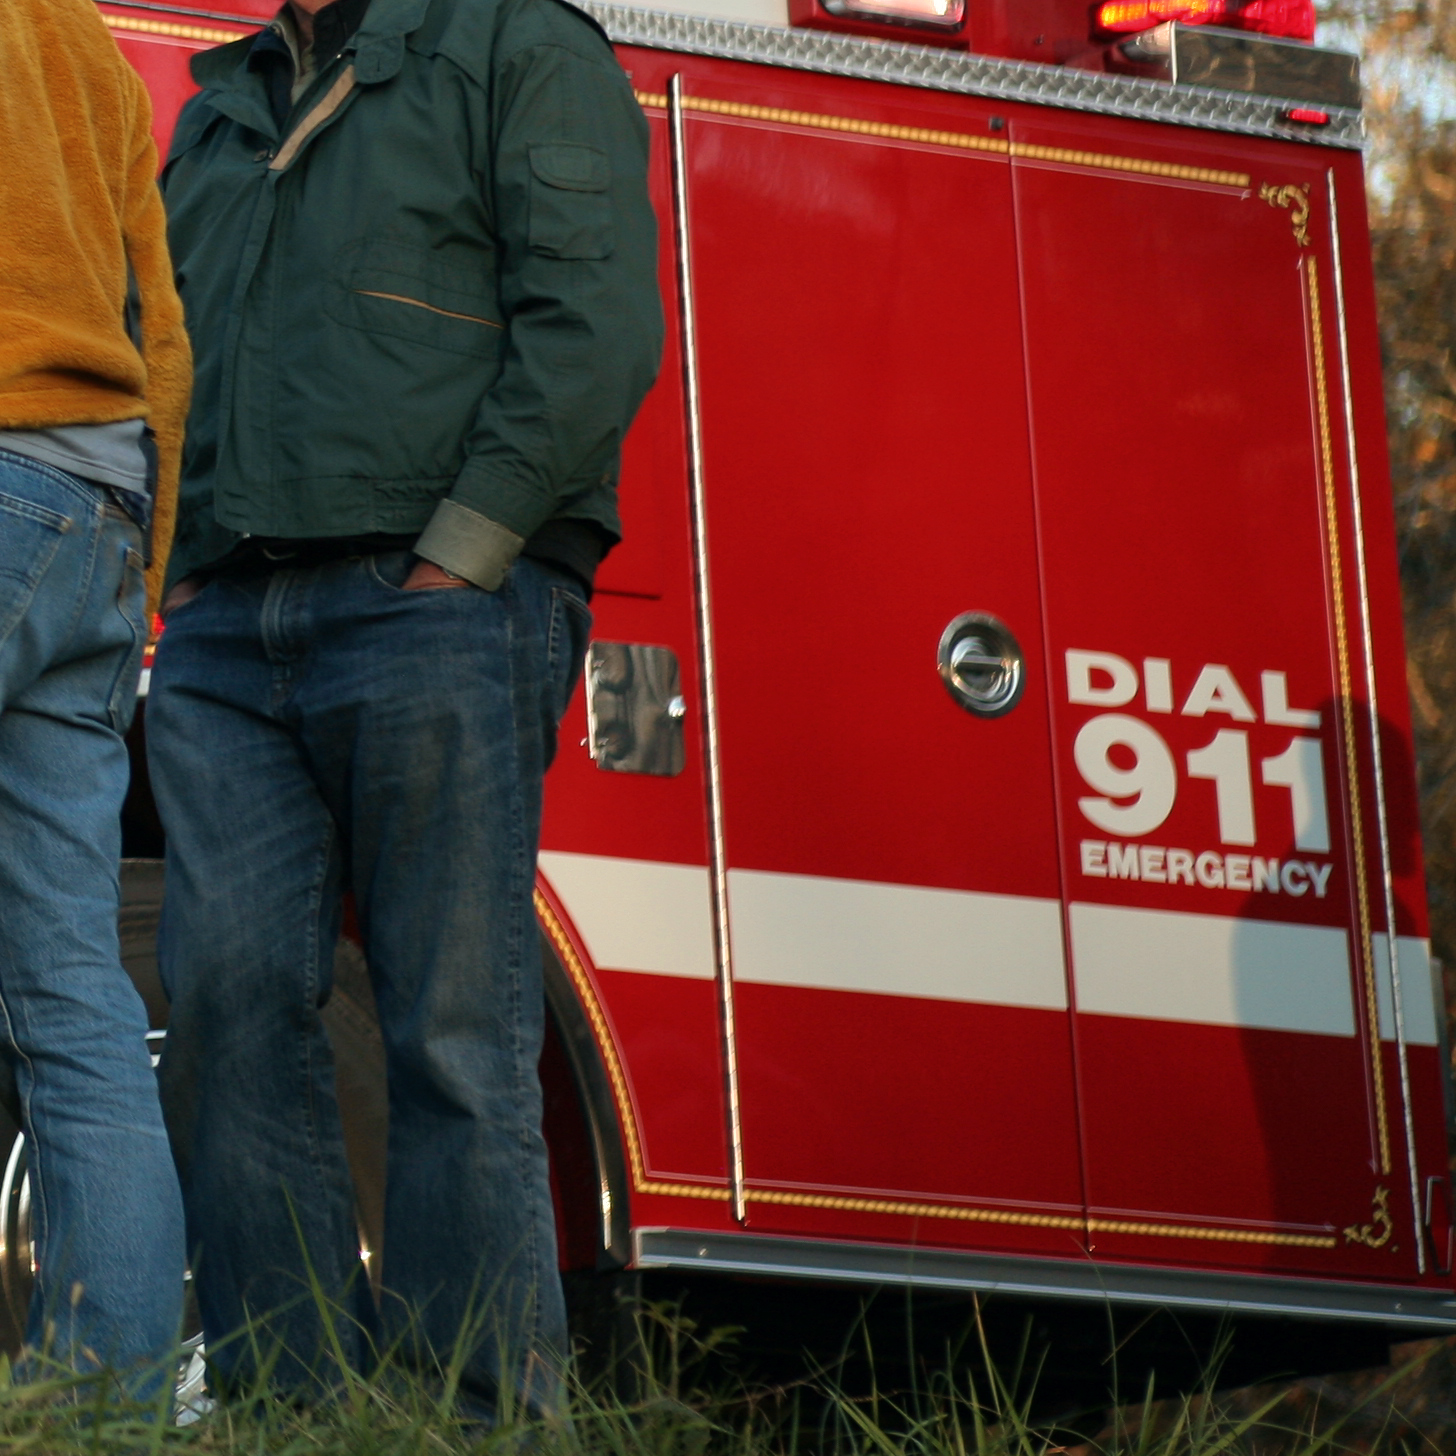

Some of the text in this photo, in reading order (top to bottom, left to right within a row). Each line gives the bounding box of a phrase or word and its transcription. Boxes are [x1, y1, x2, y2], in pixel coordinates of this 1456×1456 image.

[1064, 647, 1323, 729] DIAL
[1073, 712, 1331, 854] 911
[1079, 838, 1334, 898] EMERGENCY
